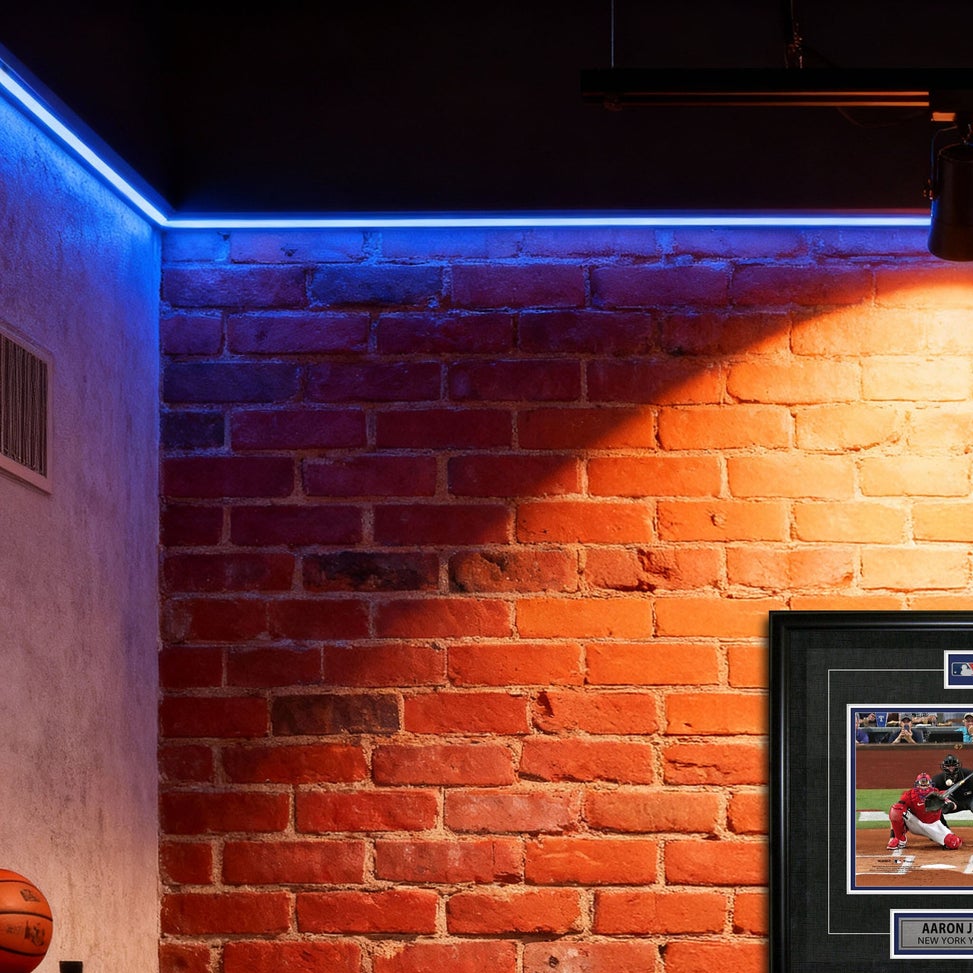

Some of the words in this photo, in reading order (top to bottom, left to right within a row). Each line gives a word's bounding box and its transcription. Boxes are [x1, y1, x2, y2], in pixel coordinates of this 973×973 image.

[921, 922, 964, 934] AARON
[917, 936, 939, 945] NEW
[941, 936, 966, 945] YORK
